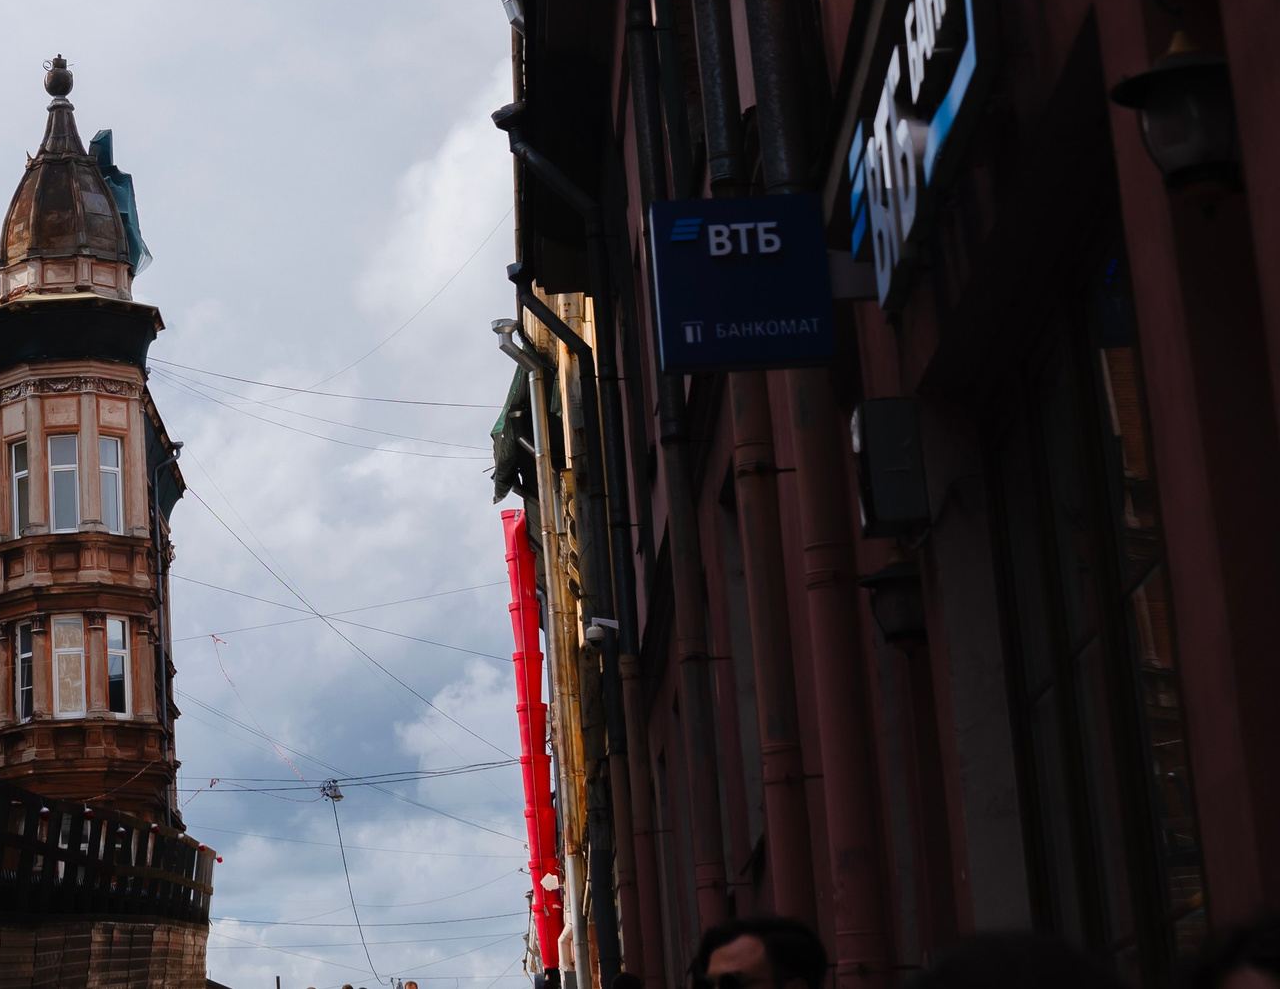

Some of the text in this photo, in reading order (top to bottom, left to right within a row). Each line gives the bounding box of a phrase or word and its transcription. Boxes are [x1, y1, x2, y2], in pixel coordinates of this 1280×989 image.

[865, 44, 918, 310] ВТБ
[707, 221, 782, 256] ВТБ
[716, 317, 820, 339] БАНКОМАТ
